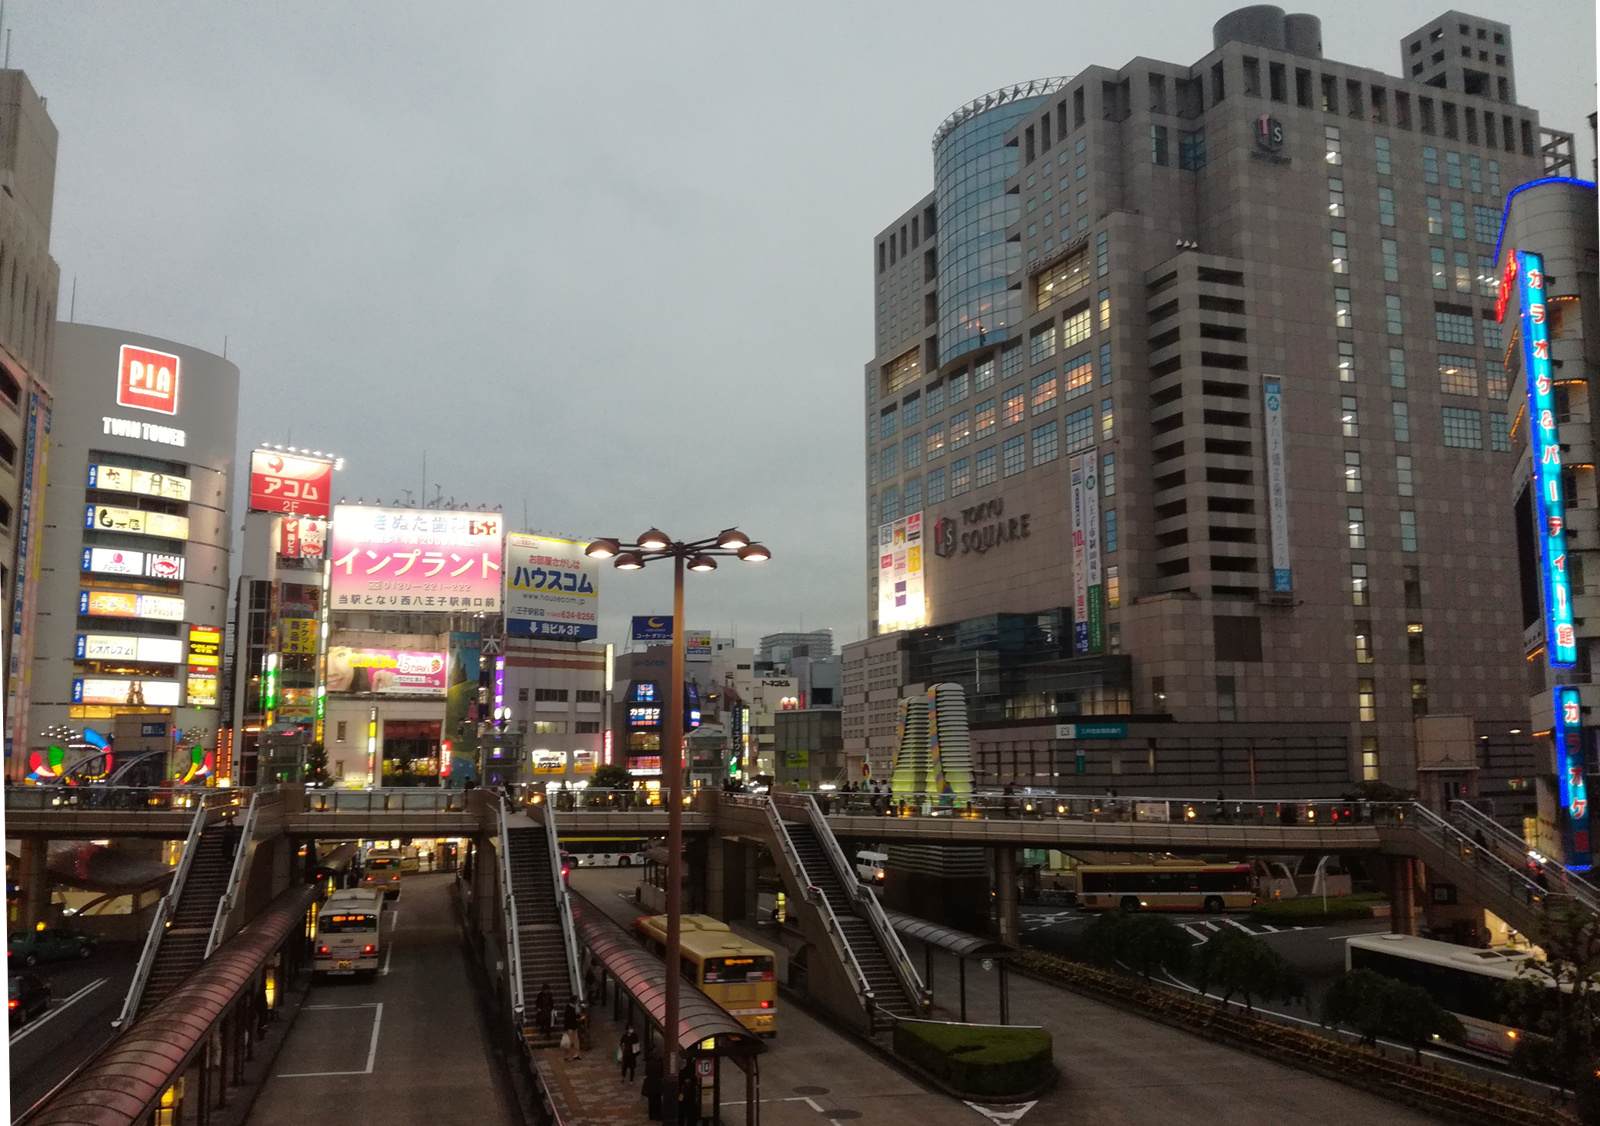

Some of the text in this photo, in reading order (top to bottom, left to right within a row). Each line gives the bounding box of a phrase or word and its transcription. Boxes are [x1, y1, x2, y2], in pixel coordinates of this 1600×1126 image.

[128, 360, 170, 392] PIA
[102, 416, 187, 447] TWIN TOWER
[264, 476, 319, 500] アコム
[282, 501, 300, 512] 2F
[961, 496, 1004, 526] TOKYU
[961, 513, 1031, 555] SQUARE
[334, 547, 500, 580] インプラント
[528, 554, 581, 570] お部屋さがしは
[513, 566, 594, 594] ハウスコム
[338, 594, 496, 608] 当駅となり西八王子駅南口前
[522, 593, 586, 606] www.housecom.jp
[301, 621, 310, 652] チケット
[541, 622, 581, 635] 当ビル3F
[629, 708, 661, 717] カラオケ
[700, 1062, 710, 1073] 10
